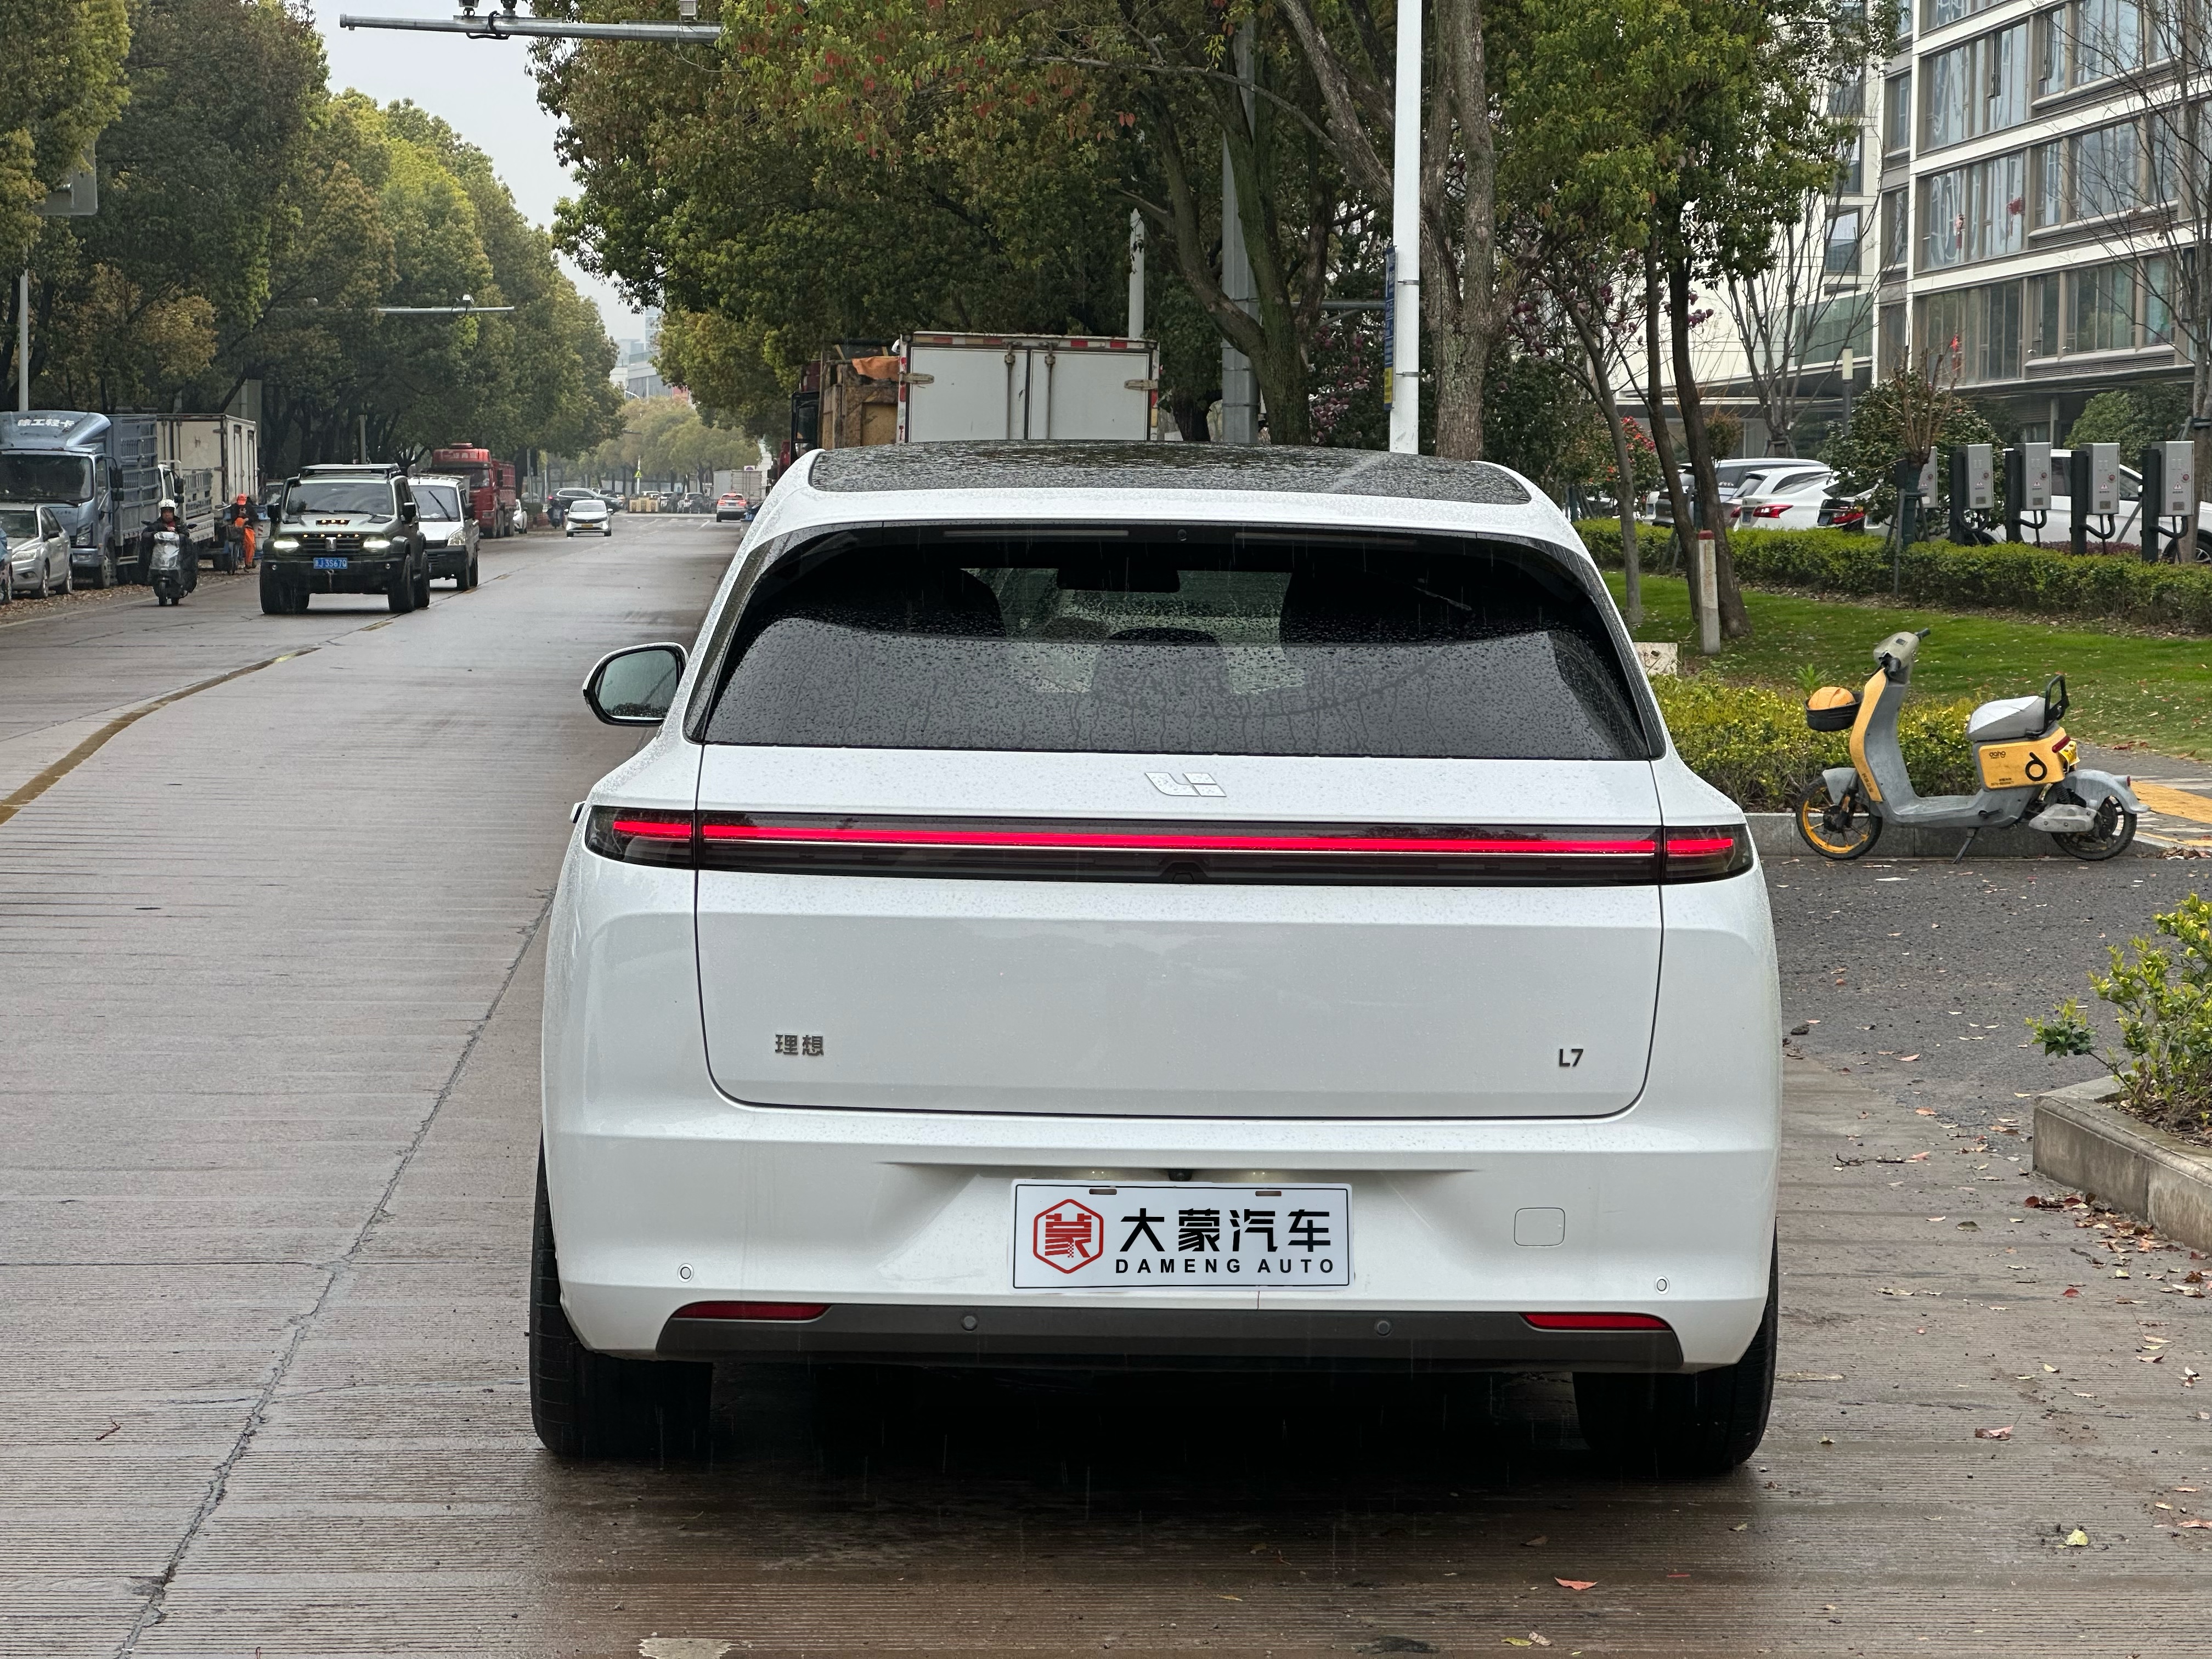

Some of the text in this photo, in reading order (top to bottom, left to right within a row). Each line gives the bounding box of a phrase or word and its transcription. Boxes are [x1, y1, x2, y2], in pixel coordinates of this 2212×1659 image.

[775, 1033, 824, 1056] 理想
[1559, 1048, 1584, 1068] L7
[1119, 1207, 1331, 1252] 大蒙汽车
[1115, 1259, 1333, 1273] DAMENG AUTO
